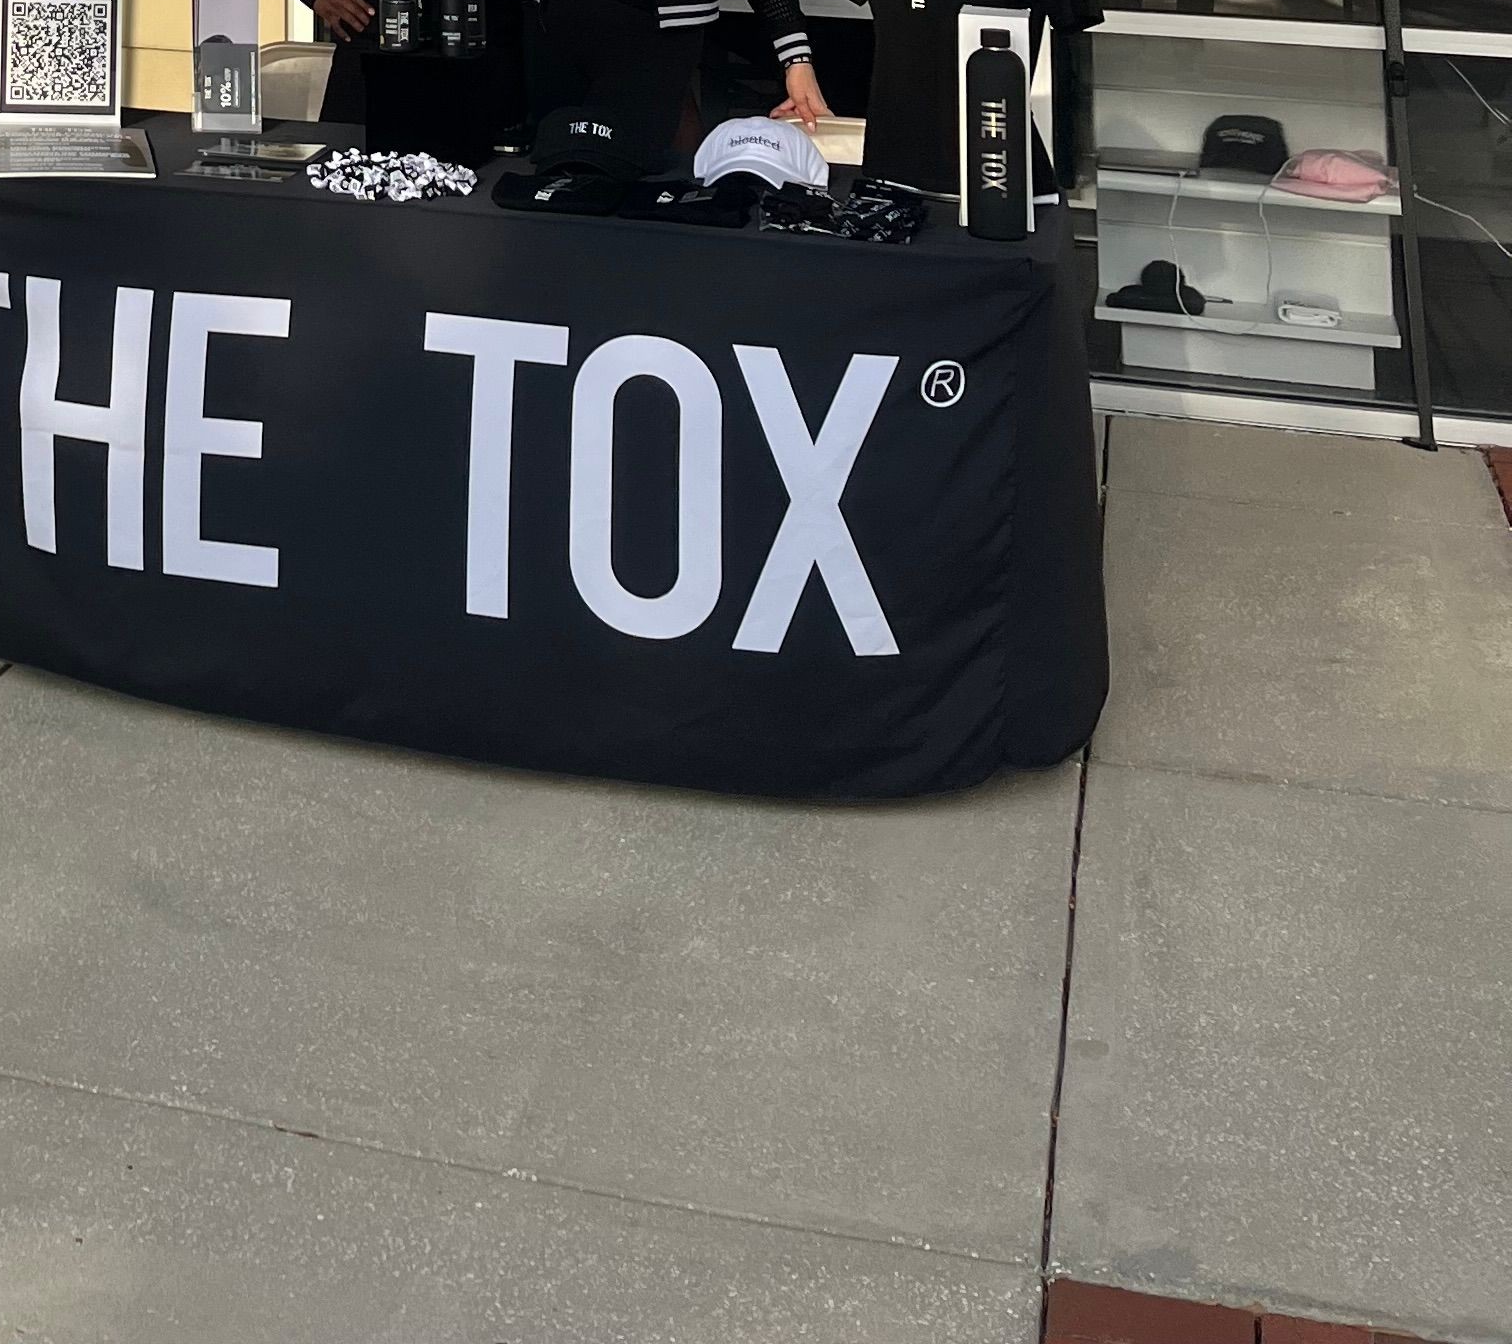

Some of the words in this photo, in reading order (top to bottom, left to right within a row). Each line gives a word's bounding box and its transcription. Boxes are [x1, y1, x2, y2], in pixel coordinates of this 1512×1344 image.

[220, 80, 232, 108] 10%
[569, 121, 588, 135] THE
[591, 122, 613, 140] TOX
[981, 98, 1007, 141] THE
